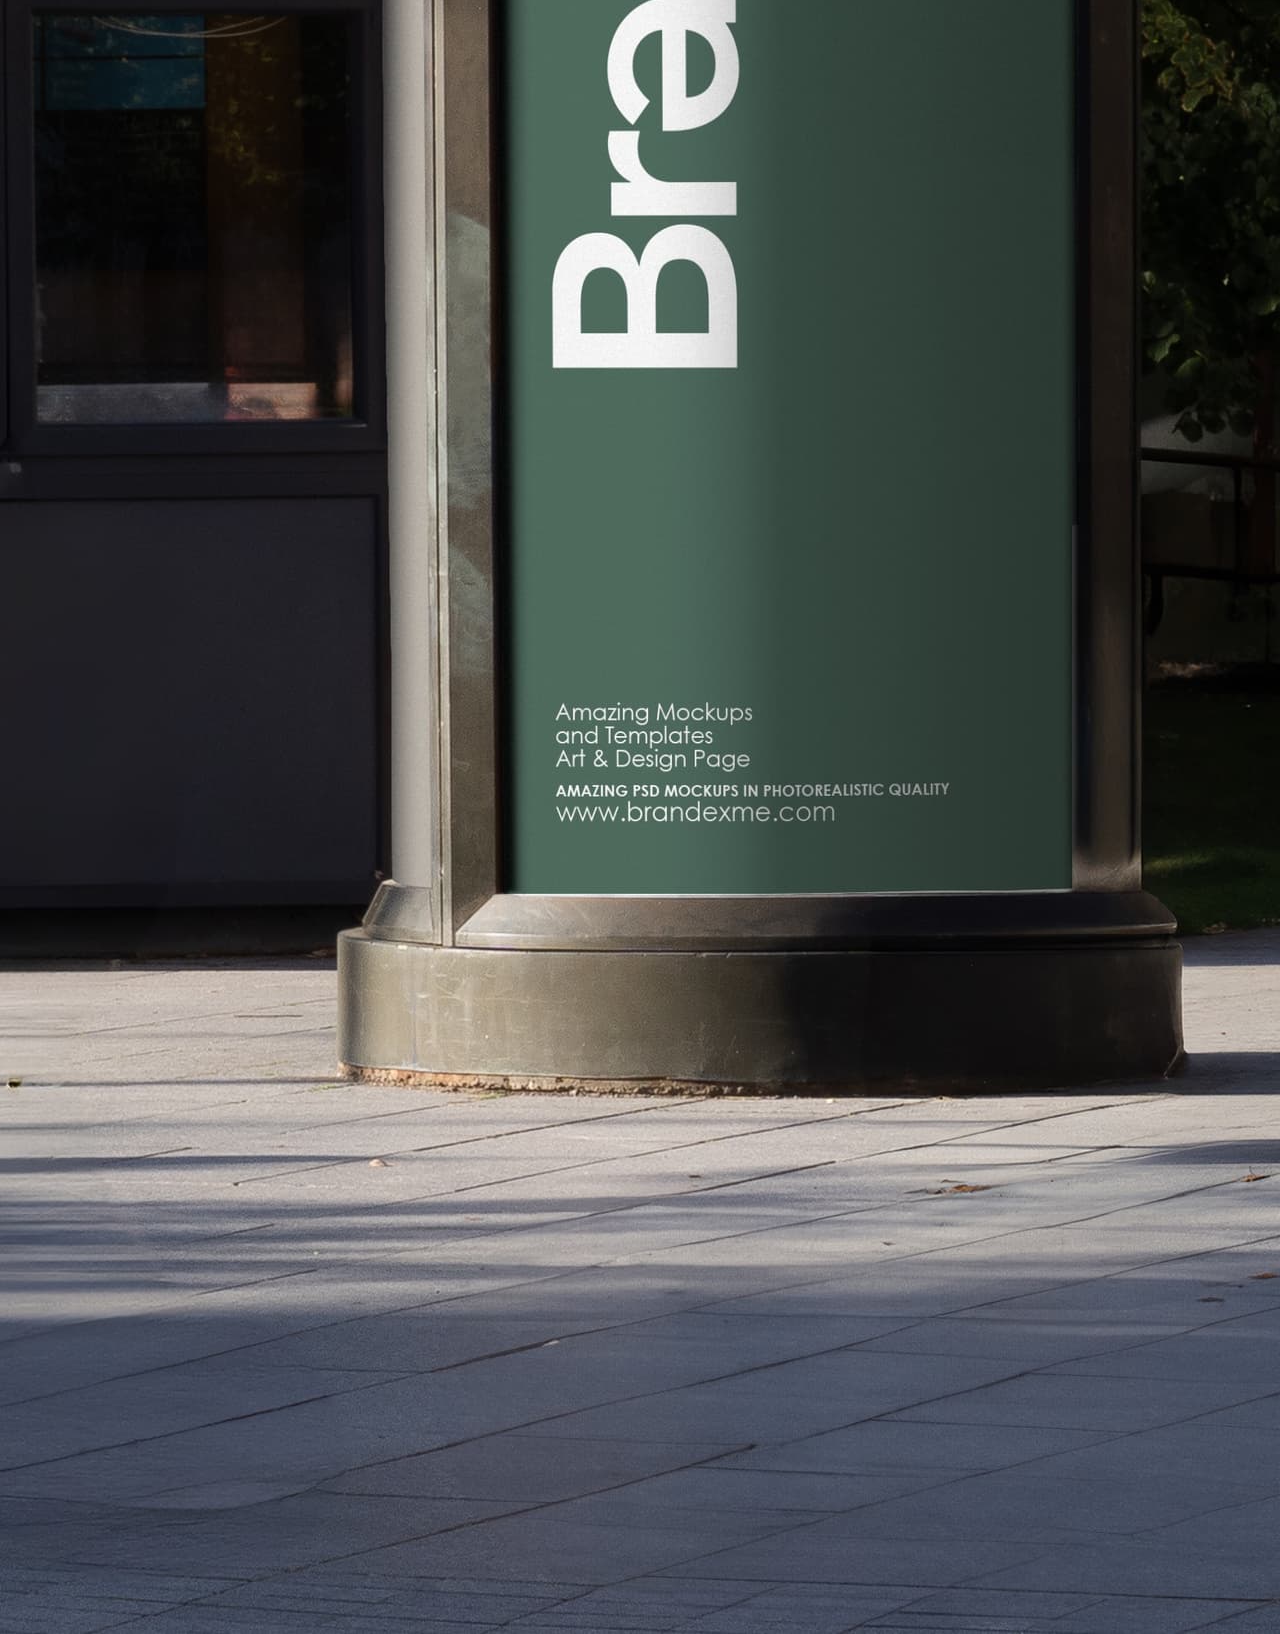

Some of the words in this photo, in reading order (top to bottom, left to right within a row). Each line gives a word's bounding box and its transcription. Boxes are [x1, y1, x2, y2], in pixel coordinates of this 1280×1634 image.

[555, 703, 650, 725] Amazing
[656, 703, 753, 725] Mockups
[555, 726, 599, 745] and
[604, 726, 714, 748] Templates
[555, 749, 587, 768] Art
[593, 749, 609, 768] &
[615, 748, 687, 772] Design
[693, 749, 751, 772] Page
[555, 784, 629, 798] AMAZING
[632, 784, 661, 798] PSD
[664, 784, 739, 798] MOCKUPS
[743, 784, 759, 798] IN
[763, 783, 885, 798] PHOTOREALISTIC
[888, 782, 950, 797] QUALITY
[555, 801, 836, 823] www.brandexme.com
